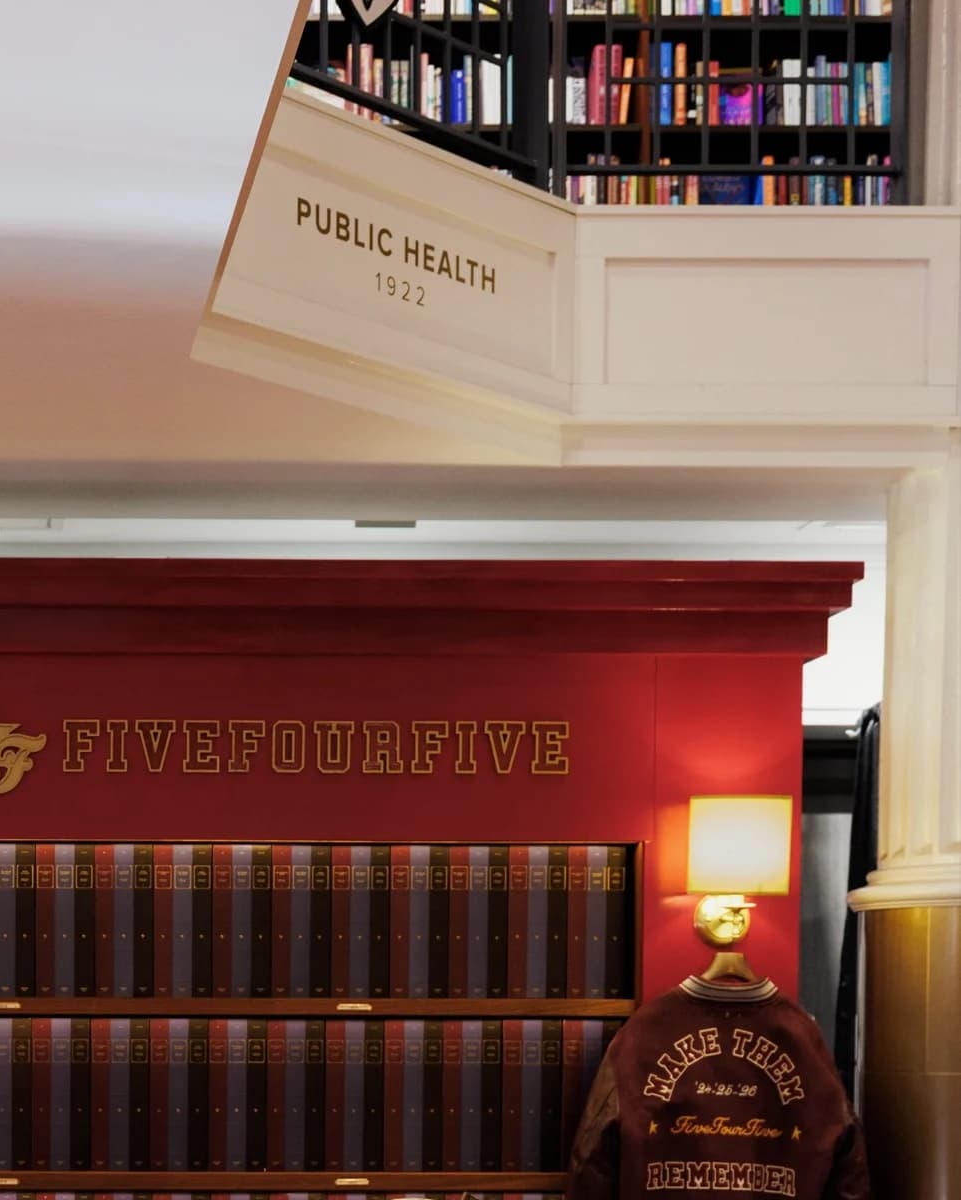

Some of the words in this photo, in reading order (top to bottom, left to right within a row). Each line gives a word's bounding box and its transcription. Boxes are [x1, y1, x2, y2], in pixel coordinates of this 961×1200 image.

[296, 197, 393, 257] PUBLIC
[404, 236, 496, 294] HEALTH
[375, 272, 426, 307] 1922
[62, 718, 570, 775] FIVEFOURFIVE
[643, 1027, 722, 1102] MAKE
[732, 1028, 805, 1105] THEM
[670, 1115, 783, 1138] FiveFourFive
[646, 1161, 797, 1198] REMEMBER
